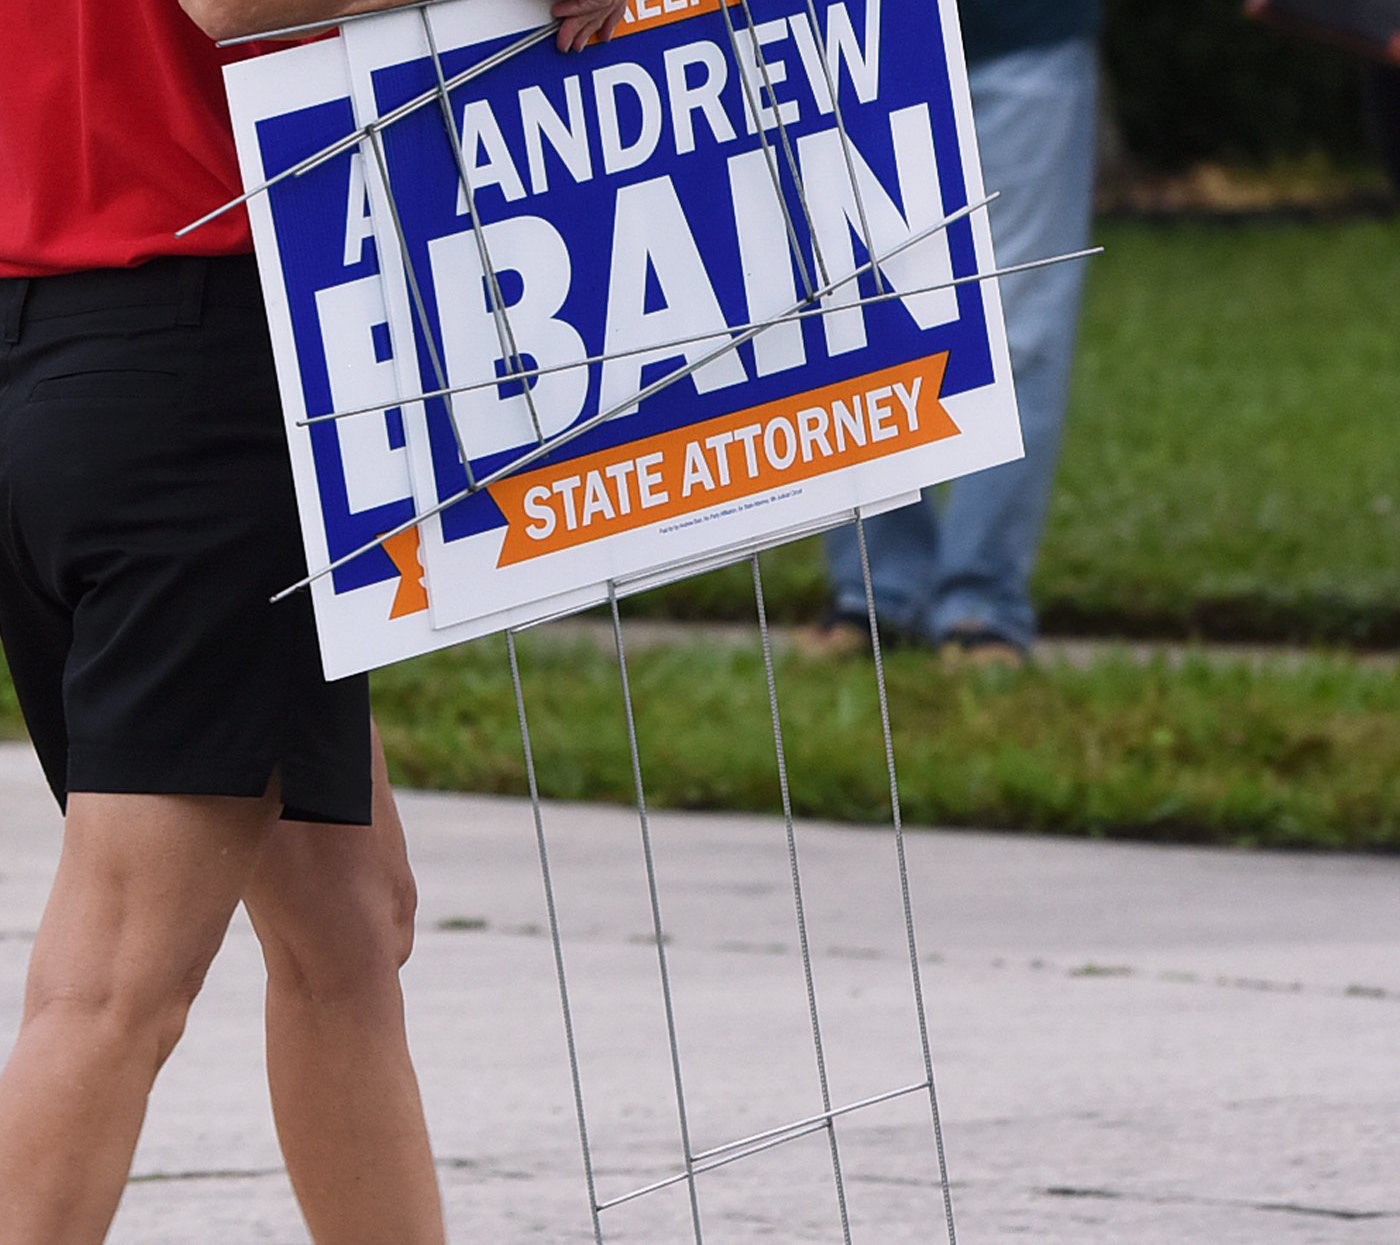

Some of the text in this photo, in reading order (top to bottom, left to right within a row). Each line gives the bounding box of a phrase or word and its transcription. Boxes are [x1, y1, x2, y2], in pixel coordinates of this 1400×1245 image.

[427, 101, 961, 460] BAIN
[523, 451, 667, 541] STATE
[681, 376, 924, 488] ATTORNEY
